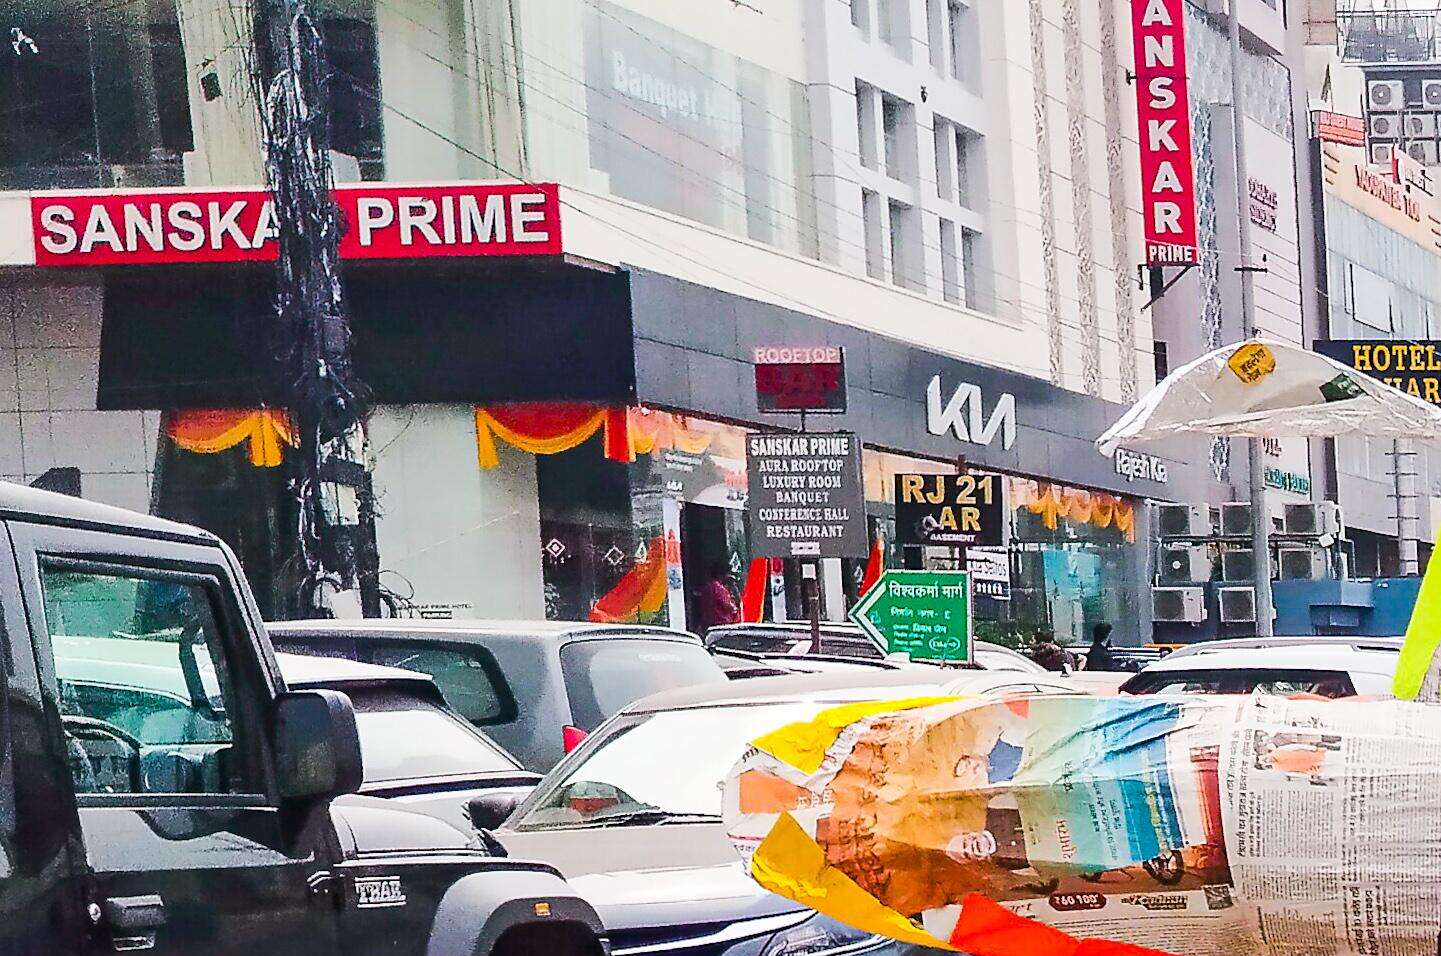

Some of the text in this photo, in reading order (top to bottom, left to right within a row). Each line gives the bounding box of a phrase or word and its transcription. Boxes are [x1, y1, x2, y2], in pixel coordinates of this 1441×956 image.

[40, 193, 550, 254] SANSKA PRIME
[1148, 245, 1193, 263] PRIME
[755, 347, 841, 364] ROOFTOP
[1353, 344, 1441, 371] HOTEL
[750, 437, 849, 456] SANSKAR PRIME
[759, 459, 844, 472] AURA ROOFTOP
[762, 476, 842, 489] LUXURY ROOM
[901, 474, 993, 505] RJ 21
[776, 491, 829, 505] BANQUET
[759, 508, 850, 521] CONFERENCE HALL
[766, 524, 844, 538] RESTAURANT
[888, 580, 939, 599] विश्वकर्मा
[941, 581, 963, 599] मार्ग
